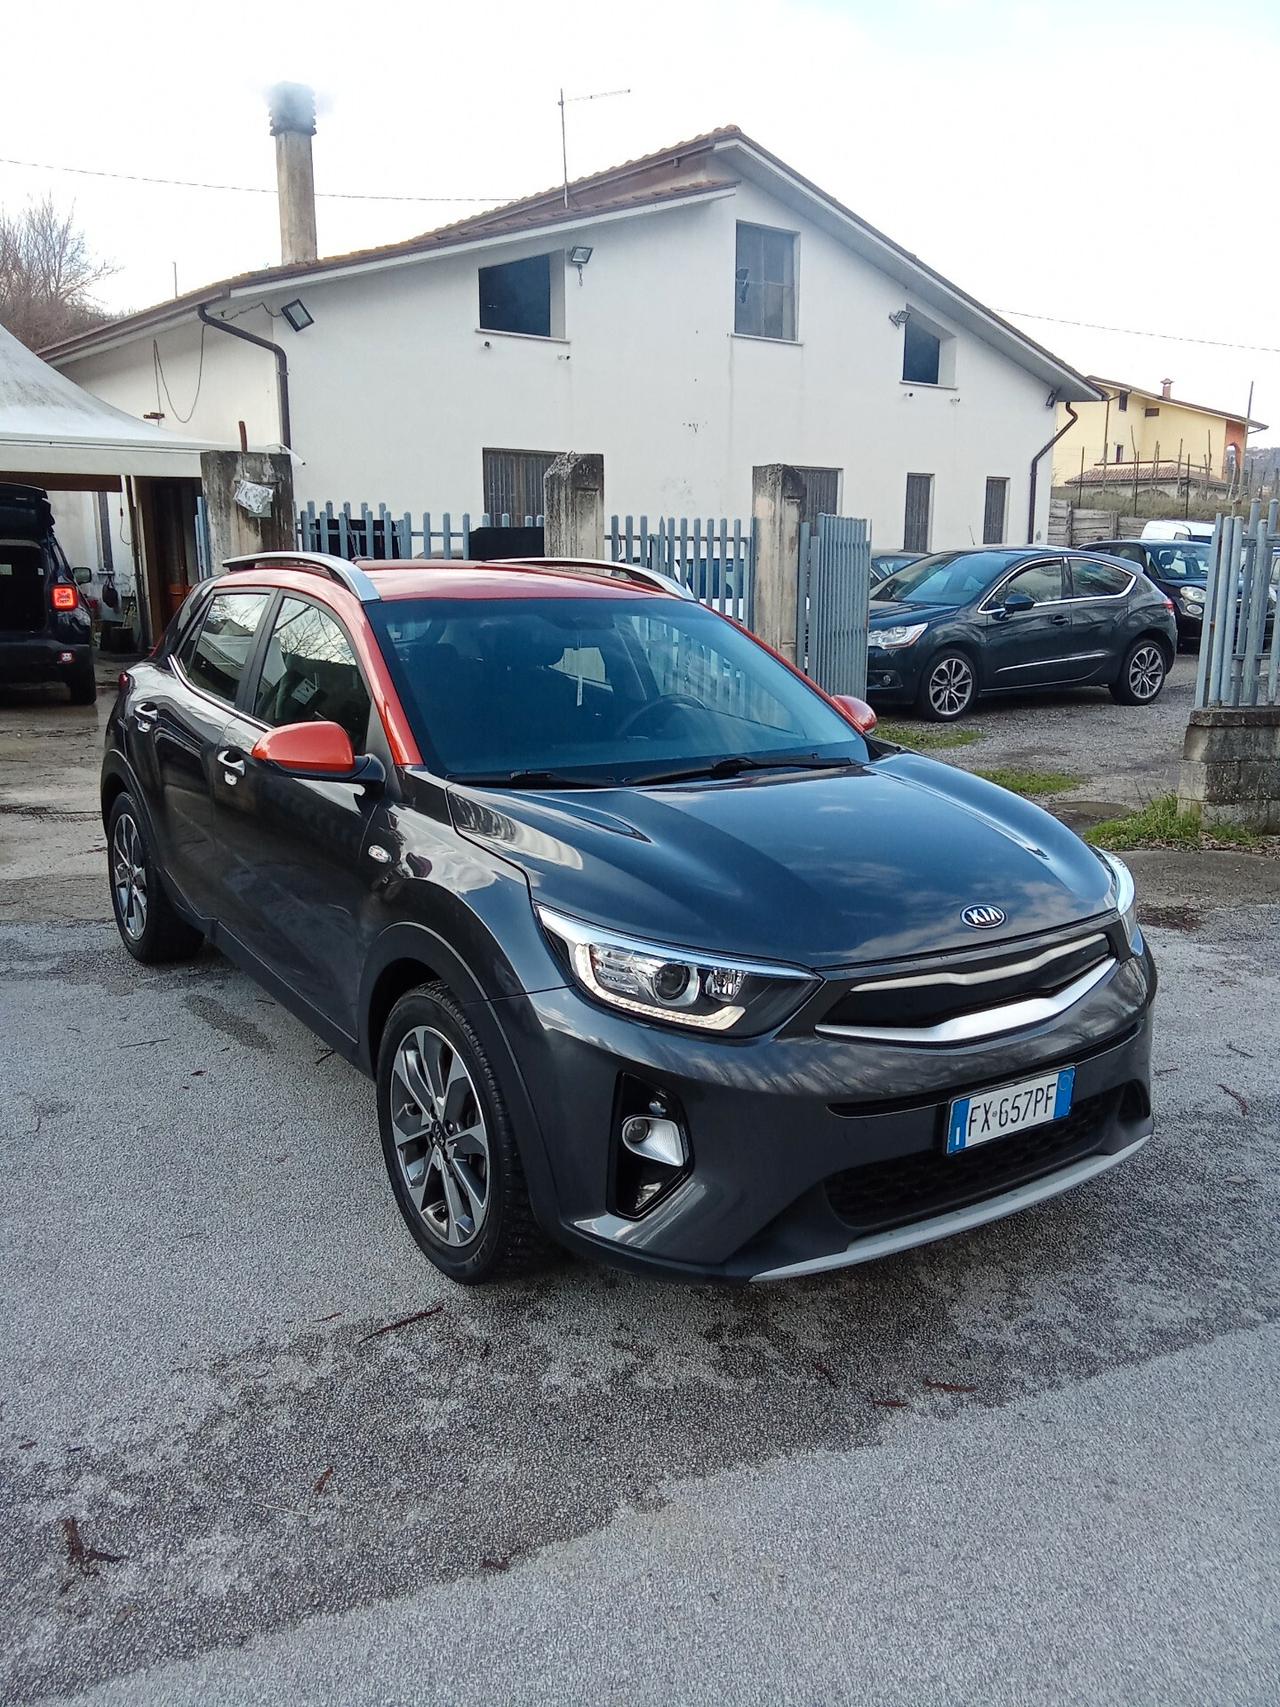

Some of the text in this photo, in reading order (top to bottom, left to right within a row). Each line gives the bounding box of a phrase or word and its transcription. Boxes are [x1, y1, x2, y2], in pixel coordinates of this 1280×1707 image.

[967, 907, 1001, 924] KIA
[968, 1082, 1057, 1137] FX 657PF
